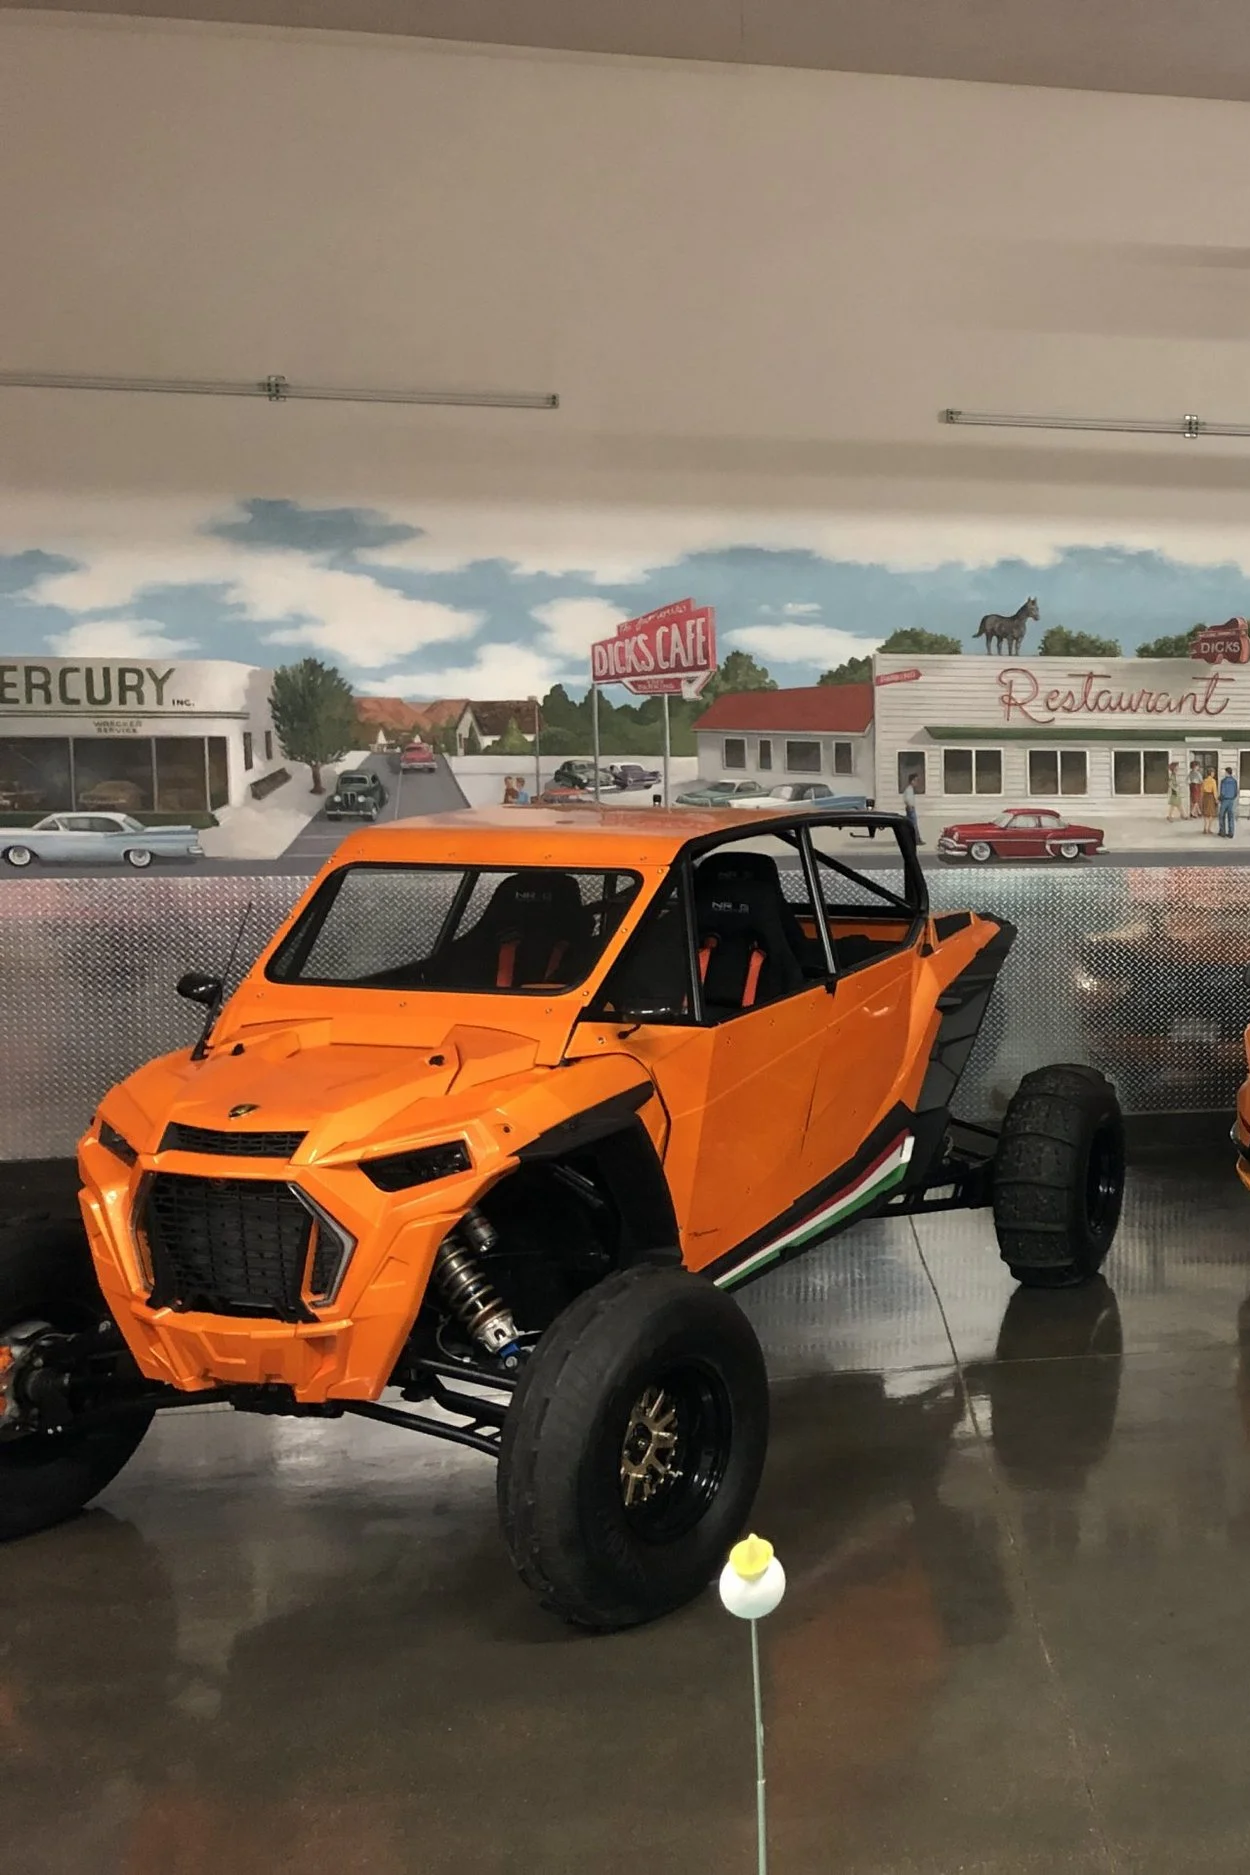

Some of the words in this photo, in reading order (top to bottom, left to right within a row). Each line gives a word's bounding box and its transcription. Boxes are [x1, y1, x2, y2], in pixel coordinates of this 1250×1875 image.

[594, 633, 655, 676] DICKS
[656, 617, 707, 669] CAFE
[1200, 641, 1240, 654] DICKS
[172, 699, 195, 707] INC.
[997, 668, 1236, 724] Restaurant
